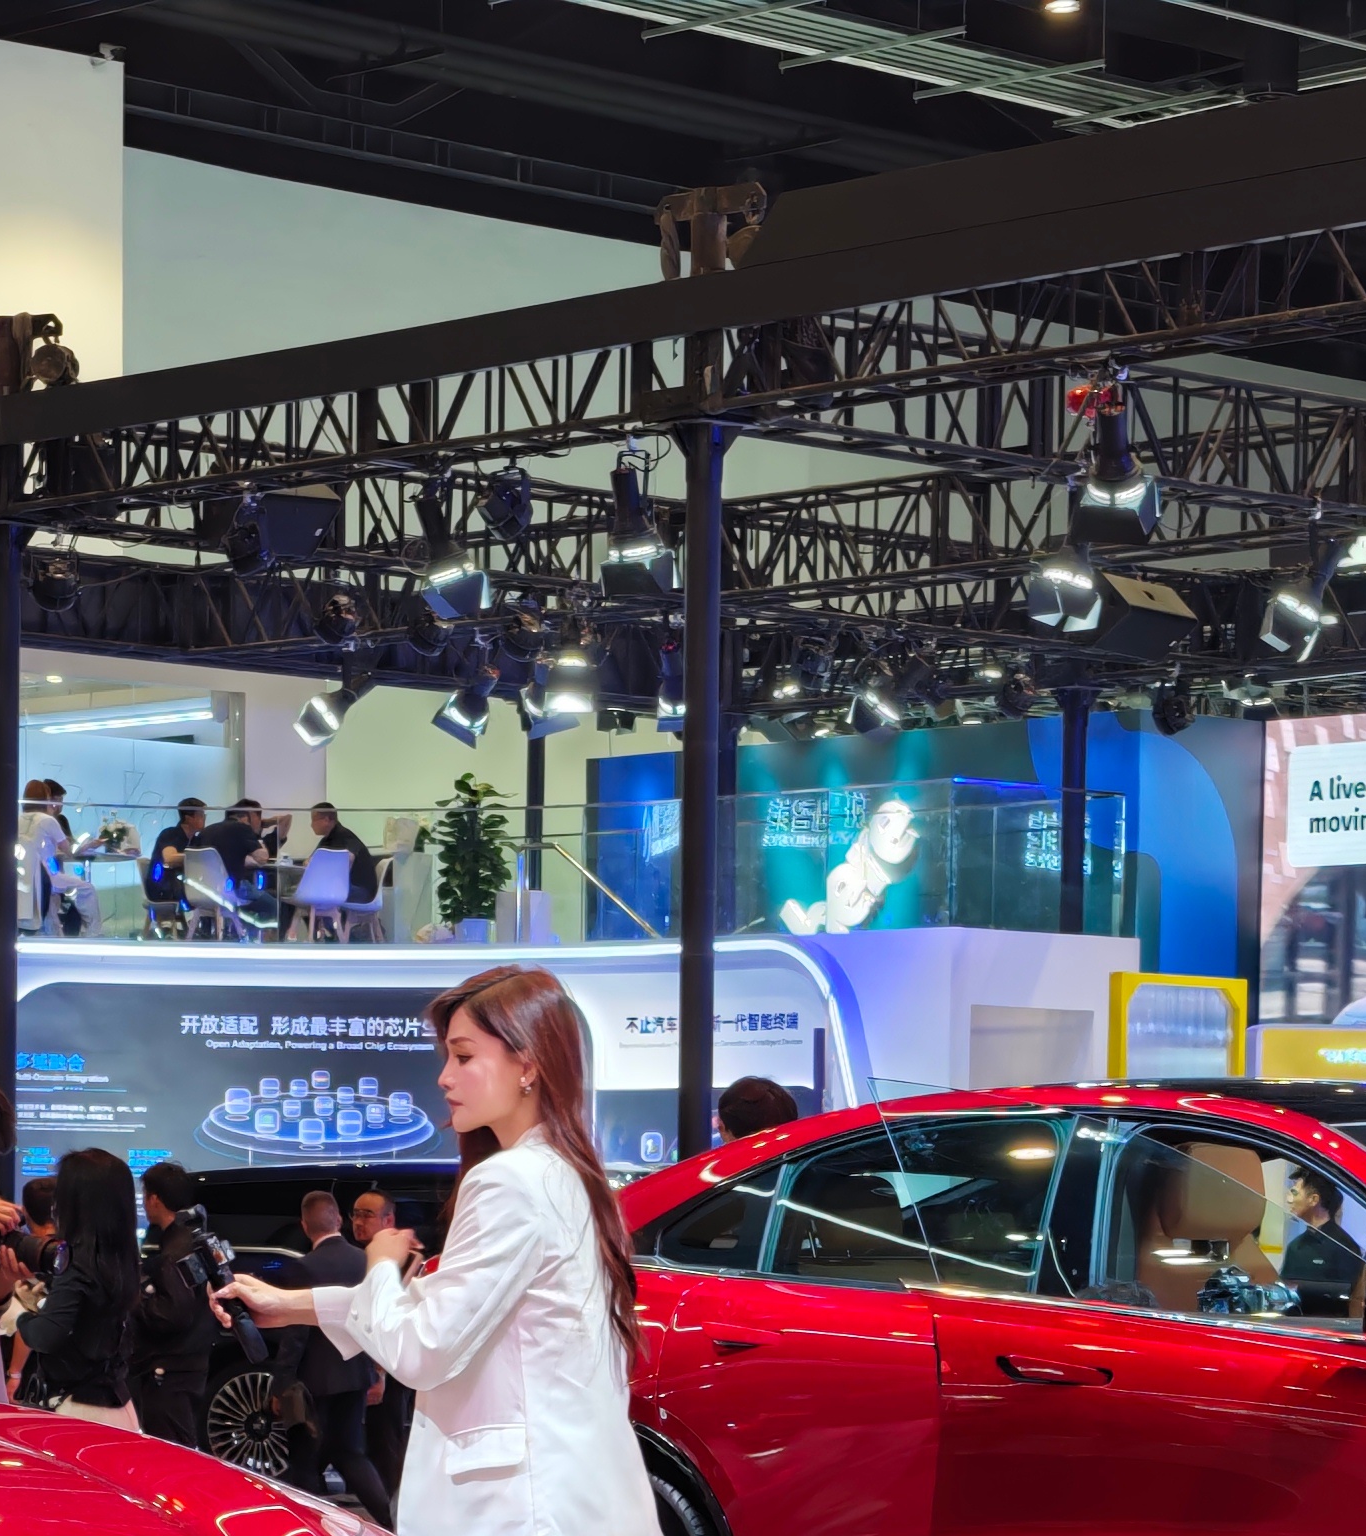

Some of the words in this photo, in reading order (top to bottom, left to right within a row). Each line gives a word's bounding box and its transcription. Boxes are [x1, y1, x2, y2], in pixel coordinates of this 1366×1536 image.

[1309, 780, 1323, 801] A
[1329, 775, 1366, 800] live
[180, 1015, 259, 1035] 开放适配
